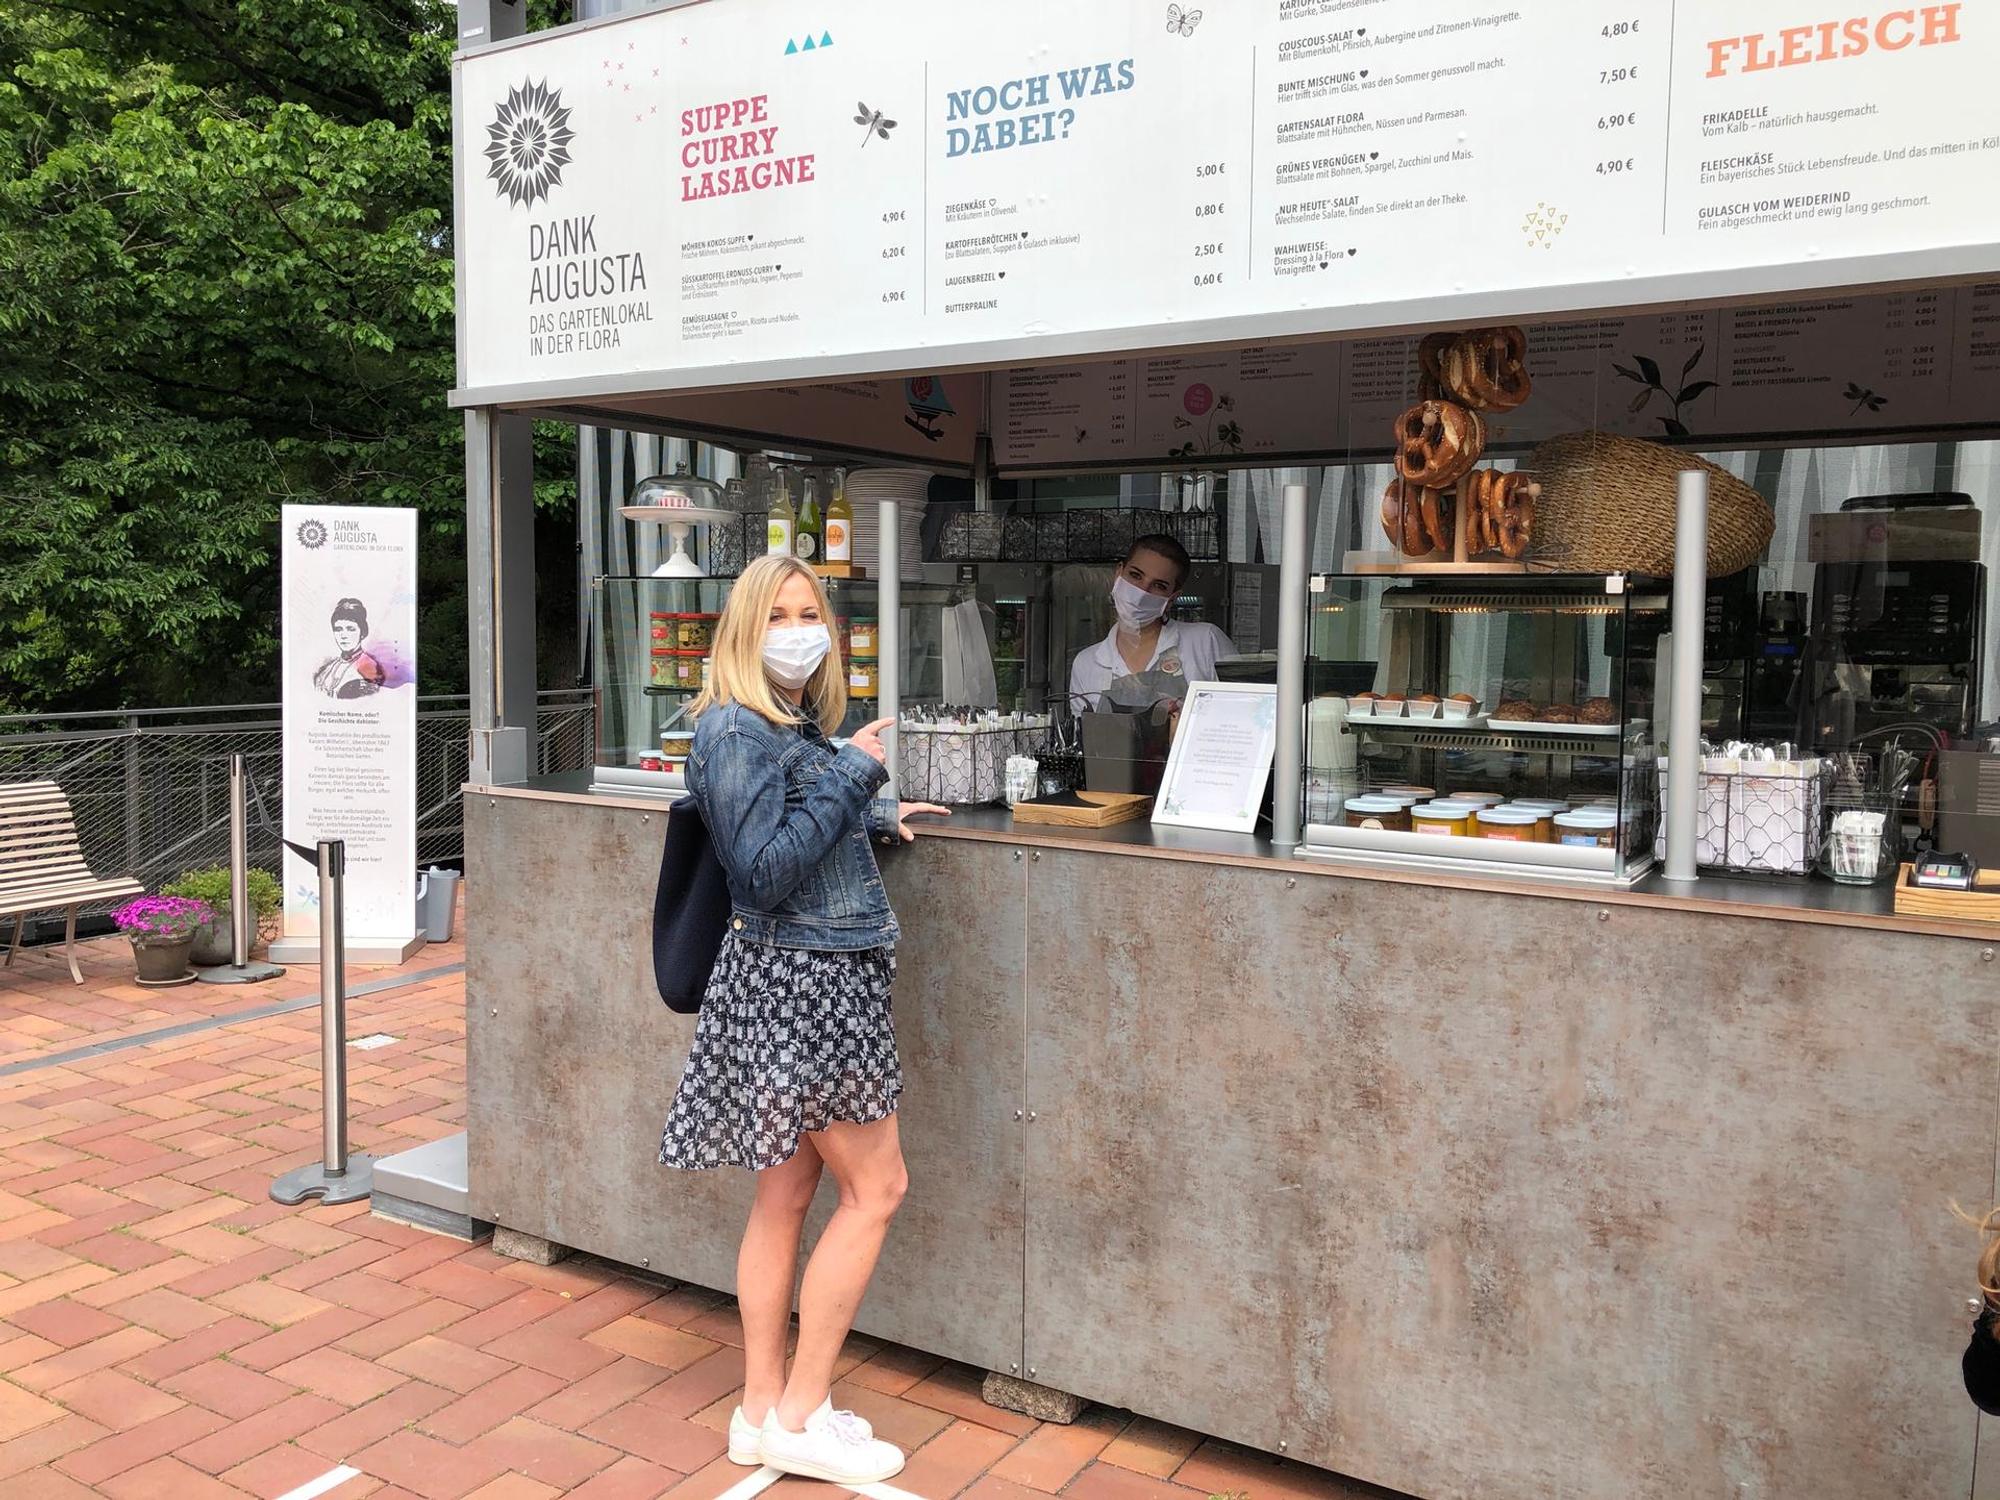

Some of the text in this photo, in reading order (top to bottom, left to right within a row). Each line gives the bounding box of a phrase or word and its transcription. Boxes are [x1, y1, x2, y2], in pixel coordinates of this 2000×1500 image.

[1280, 10, 1292, 22] Mit
[1294, 7, 1318, 18] Gurke,
[1601, 19, 1639, 38] 4,80 €
[1278, 31, 1354, 52] COUSCOUS-SALAT
[1278, 52, 1292, 62] Mit
[1293, 43, 1341, 59] Blumenkohl,
[1342, 37, 1373, 51] Pfirsich,
[1374, 32, 1416, 45] Aubergine
[1417, 26, 1434, 38] und
[1705, 2, 1962, 79] FLEISCH
[1277, 94, 1293, 103] Hier
[1312, 87, 1327, 97] sich
[1329, 86, 1340, 95] im
[1341, 83, 1360, 93] Glas,
[1361, 81, 1378, 90] was
[1379, 78, 1394, 87] den
[1396, 73, 1429, 84] Sommer
[1430, 64, 1475, 81] genussvoll
[1477, 60, 1506, 72] macht.
[1278, 71, 1355, 92] BUNTE MISCHUNG
[1600, 66, 1638, 84] 7,50 €
[946, 58, 1136, 121] NOCH WAS
[681, 94, 768, 136] SUPPE
[1277, 112, 1364, 133] GARTENSALAT FLORA
[1597, 112, 1636, 130] 6,90 €
[1702, 106, 1768, 125] FRIKADELLE
[1702, 126, 1724, 137] Vom
[1726, 121, 1749, 133] Kalb
[1759, 113, 1803, 129] natürlich
[1806, 104, 1879, 123] hausgemacht.
[946, 108, 1076, 158] DABEI?
[1277, 110, 1468, 143] Blattsalate mit Hühnchen, Nüssen und Parmesan.
[682, 126, 778, 168] CURRY
[1196, 162, 1225, 178] 5,00 €
[1276, 153, 1366, 174] GRÜNES VERGNÜGEN
[1276, 152, 1475, 184] Blattsalate mit Bohnen, Spargel, Zucchini und Mais.
[1596, 158, 1634, 175] 4,90 €
[1700, 152, 1774, 171] FLEISCHKÄSE
[1700, 173, 1715, 183] Ein
[1717, 166, 1776, 182] bayerisches
[1777, 161, 1805, 174] Stück
[1807, 153, 1881, 170] Lebensfreude.
[1883, 149, 1906, 161] Und
[1908, 148, 1928, 158] das
[1930, 143, 1967, 155] mitten
[1968, 141, 1980, 151] in
[681, 154, 815, 202] LASAGNE
[945, 199, 986, 213] ZIEGENKÄSE
[1195, 203, 1224, 218] 0,80 €
[1275, 212, 1320, 225] Wechselnde
[1322, 210, 1348, 219] Salate,
[1350, 206, 1374, 216] finden
[1375, 204, 1389, 213] Sie
[1390, 200, 1413, 211] direkt
[1426, 198, 1441, 207] der
[1441, 194, 1468, 205] Theke.
[1698, 191, 1851, 218] GULASCH VOM WEIDERIND
[1698, 195, 1930, 230] Fein abgeschmeckt und ewig lang geschmort.
[882, 210, 906, 224] 4,90 €
[530, 214, 597, 262] DANK
[945, 232, 1018, 249] KARTOFFELBRÖTCHEN
[1017, 241, 1022, 250] &
[1023, 238, 1048, 249] Gulasch
[1274, 240, 1328, 255] WAHLWEISE:
[882, 246, 905, 259] 6,20 €
[1194, 242, 1223, 257] 2,50 €
[1274, 255, 1308, 265] Dressing
[1315, 252, 1323, 261] la
[1324, 251, 1344, 260] Flora
[529, 252, 647, 305] AUGUSTA
[1273, 263, 1316, 275] Vinaigrette
[945, 272, 996, 286] LAUGENBREZEL
[1194, 272, 1223, 287] 0,60 €
[882, 290, 905, 303] 6,90 €
[945, 300, 998, 313] BUTTERPRALINE
[530, 301, 654, 335] DAS GARTENLOKAL
[530, 328, 621, 356] IN DER FLORA
[334, 520, 360, 531] DANK
[334, 532, 377, 543] AUGUSTA
